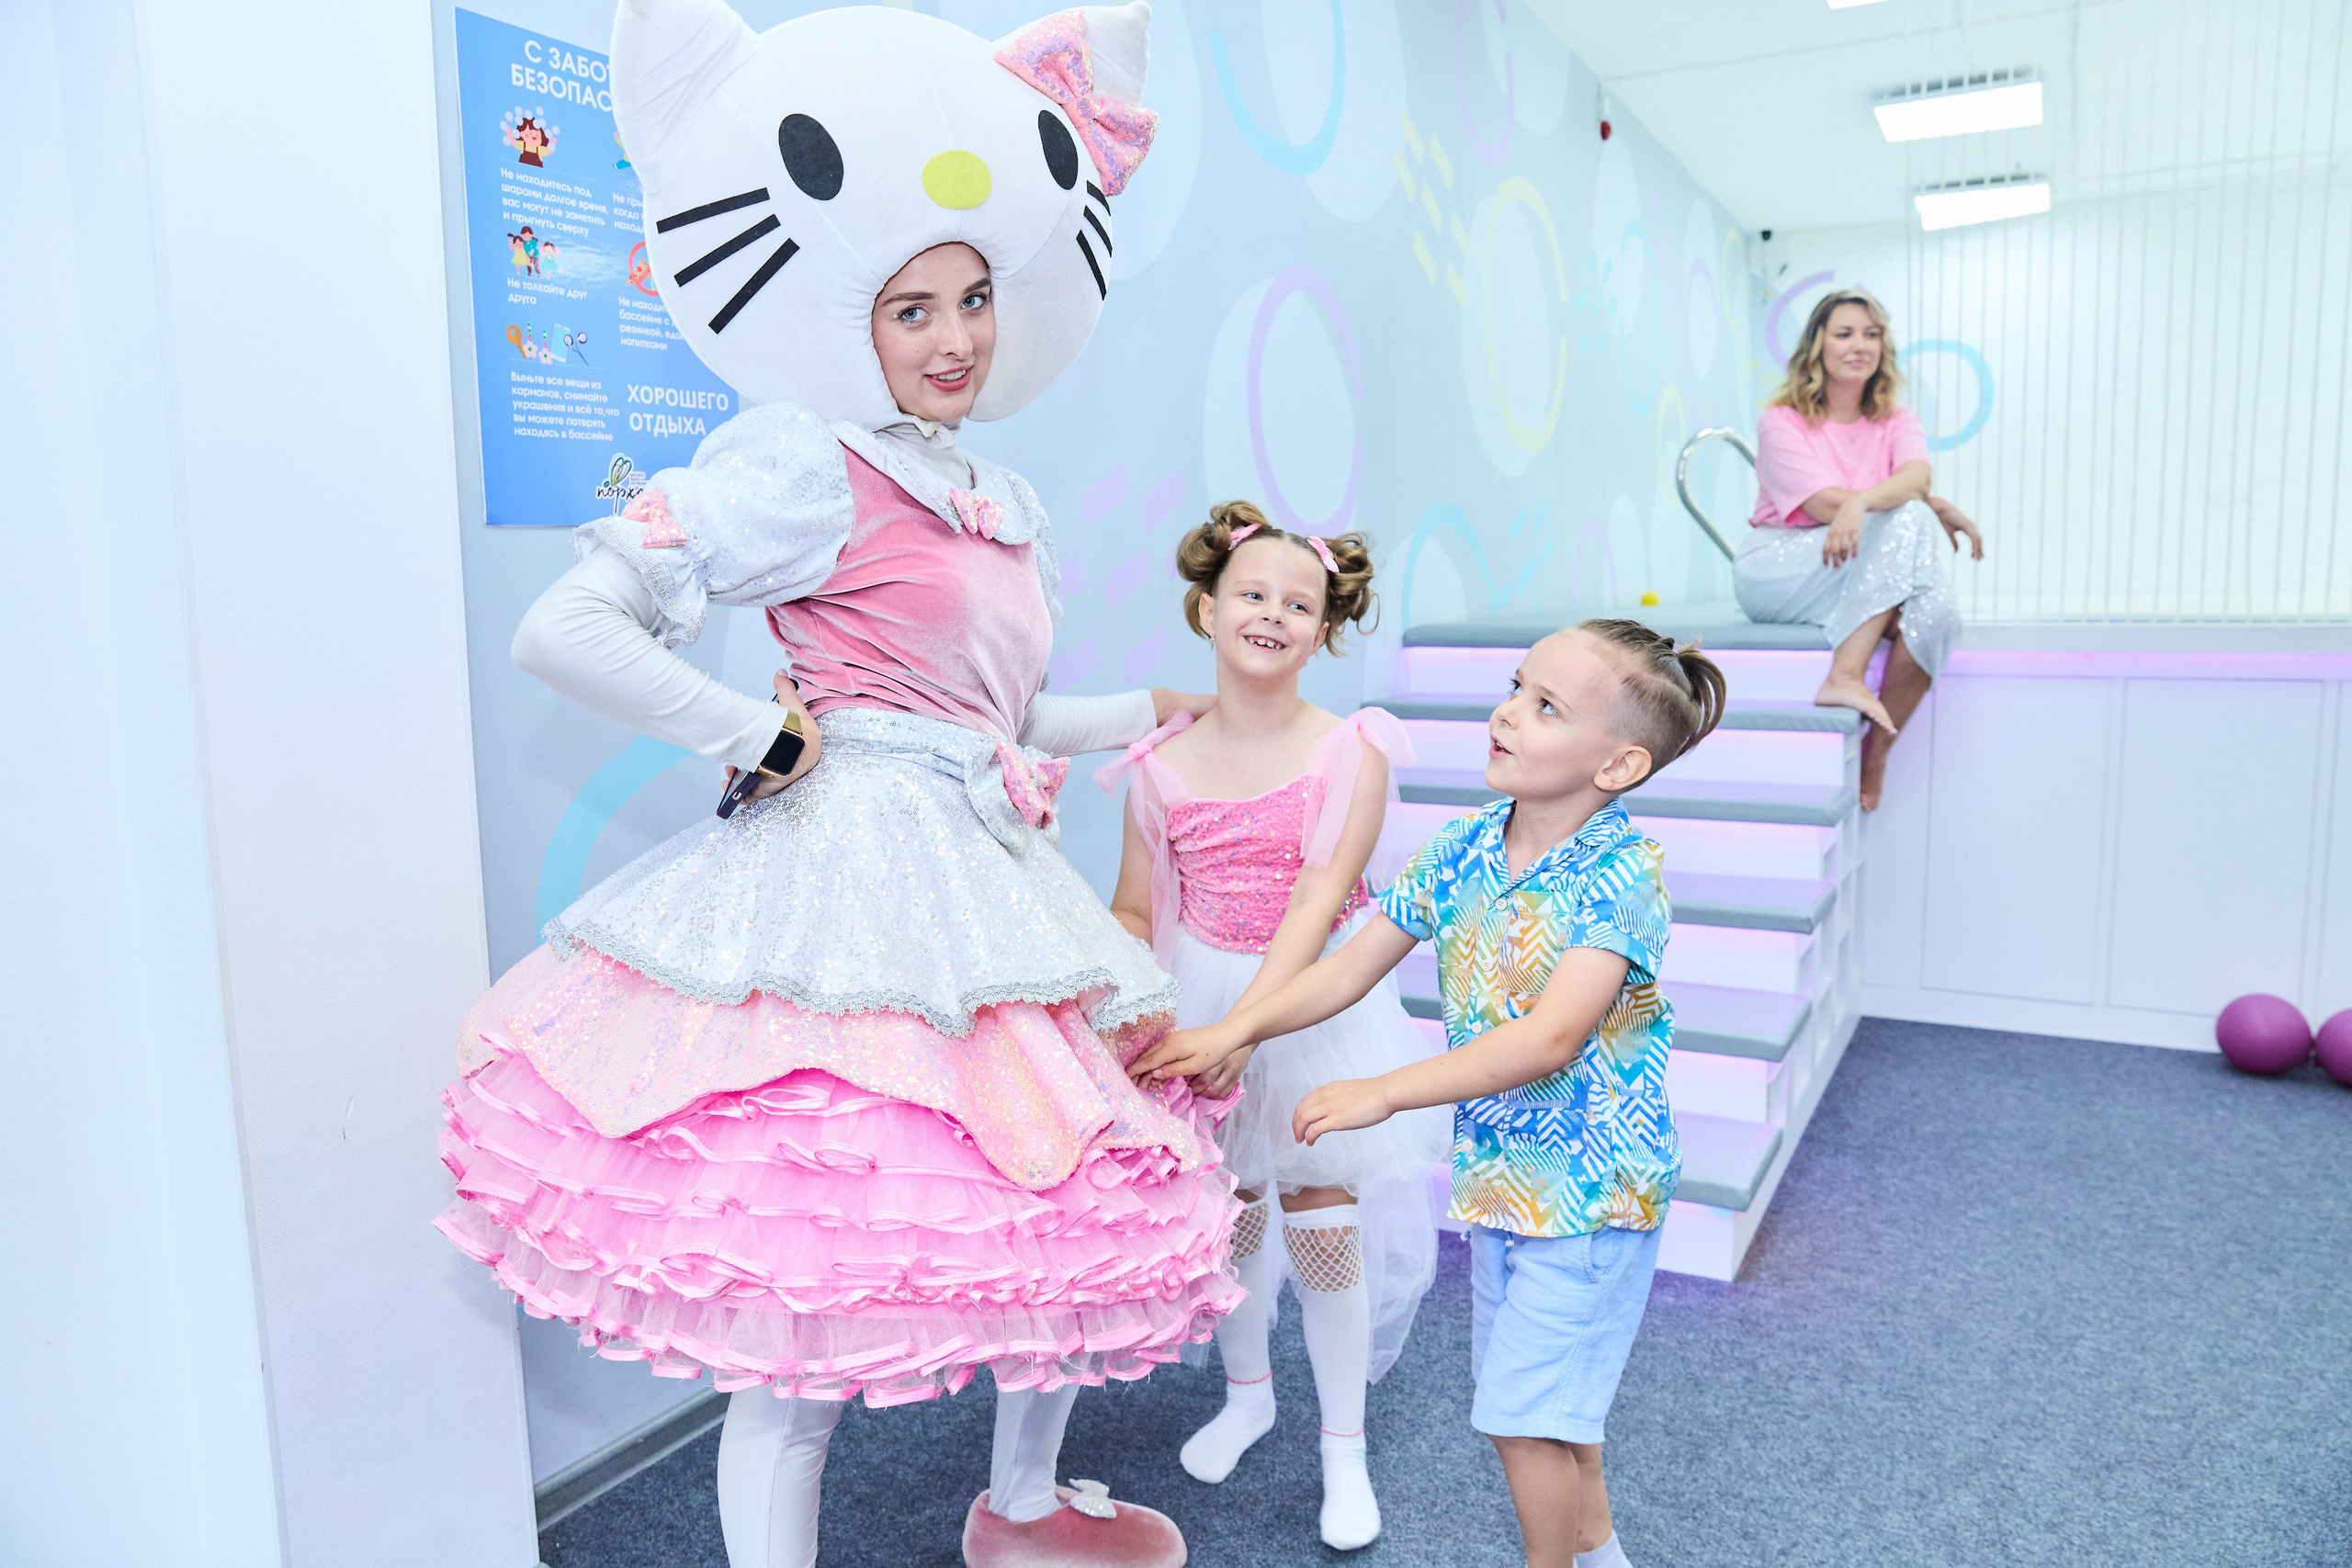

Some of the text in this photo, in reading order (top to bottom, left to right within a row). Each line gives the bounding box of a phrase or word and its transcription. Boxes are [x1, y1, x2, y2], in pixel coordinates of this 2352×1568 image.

[525, 40, 610, 83] С ЗАБО
[512, 62, 612, 111] БЕЗОПАС
[501, 167, 593, 199] Не находитесь под
[502, 183, 609, 215] шарами долгое время,
[613, 192, 625, 204] Не
[503, 197, 605, 226] вас могут не заметить
[614, 207, 639, 220] когда
[503, 211, 589, 237] и прыгнуть сверху
[507, 277, 588, 300] Не толкайте друг
[508, 293, 537, 305] друга
[619, 296, 630, 307] Не
[619, 309, 662, 324] бассейне
[620, 324, 663, 339] резинкой,
[621, 337, 667, 351] напитками
[511, 371, 602, 389] Выньте все вещи из
[512, 387, 608, 403] карманов, снимайте
[627, 384, 729, 412] ХОРОШЕГО
[513, 400, 565, 412] украшения
[527, 415, 564, 425] можете
[566, 418, 605, 429] потерять
[629, 412, 707, 437] ОТДЫХА
[514, 427, 560, 438] находясь
[569, 429, 614, 441] бассейне
